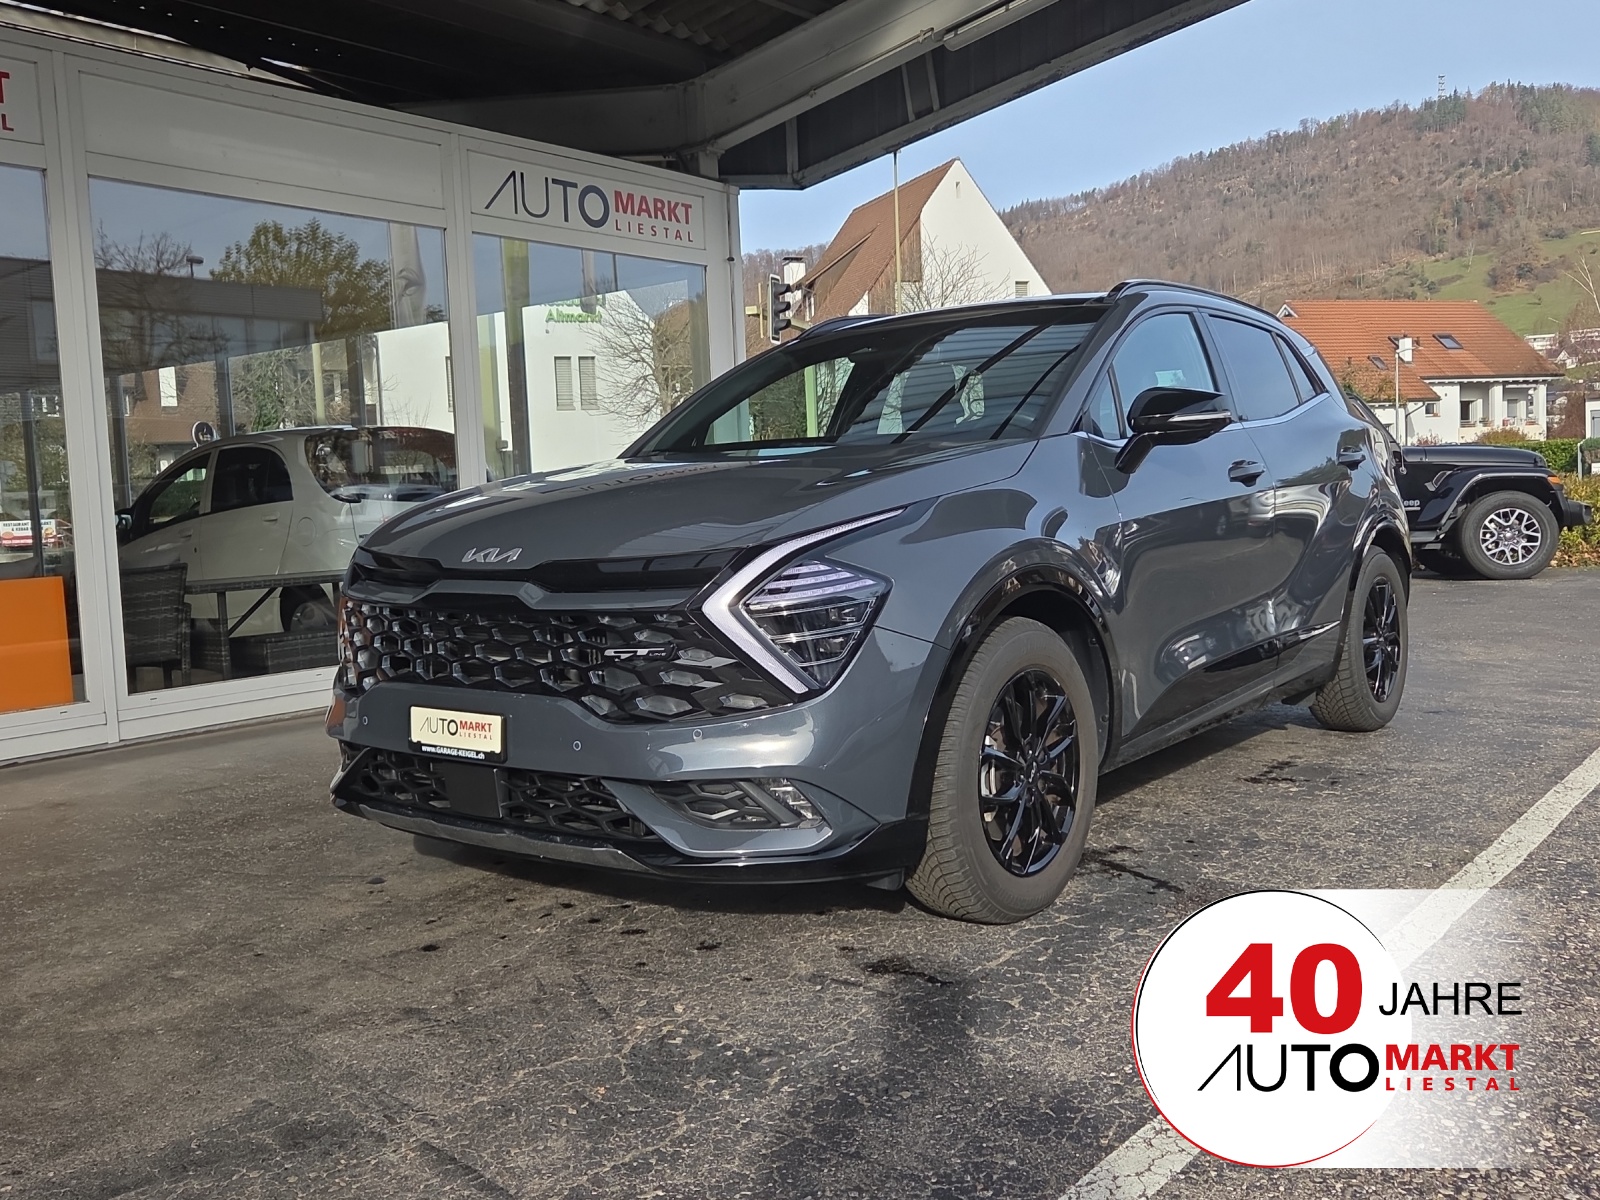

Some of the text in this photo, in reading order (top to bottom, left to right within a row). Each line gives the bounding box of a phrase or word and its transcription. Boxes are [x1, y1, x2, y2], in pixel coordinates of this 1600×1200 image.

[614, 190, 693, 225] MARKT
[615, 219, 694, 243] LIESTAL
[461, 547, 523, 562] KIA
[460, 720, 492, 733] MARKT
[460, 732, 493, 740] LIESTAL
